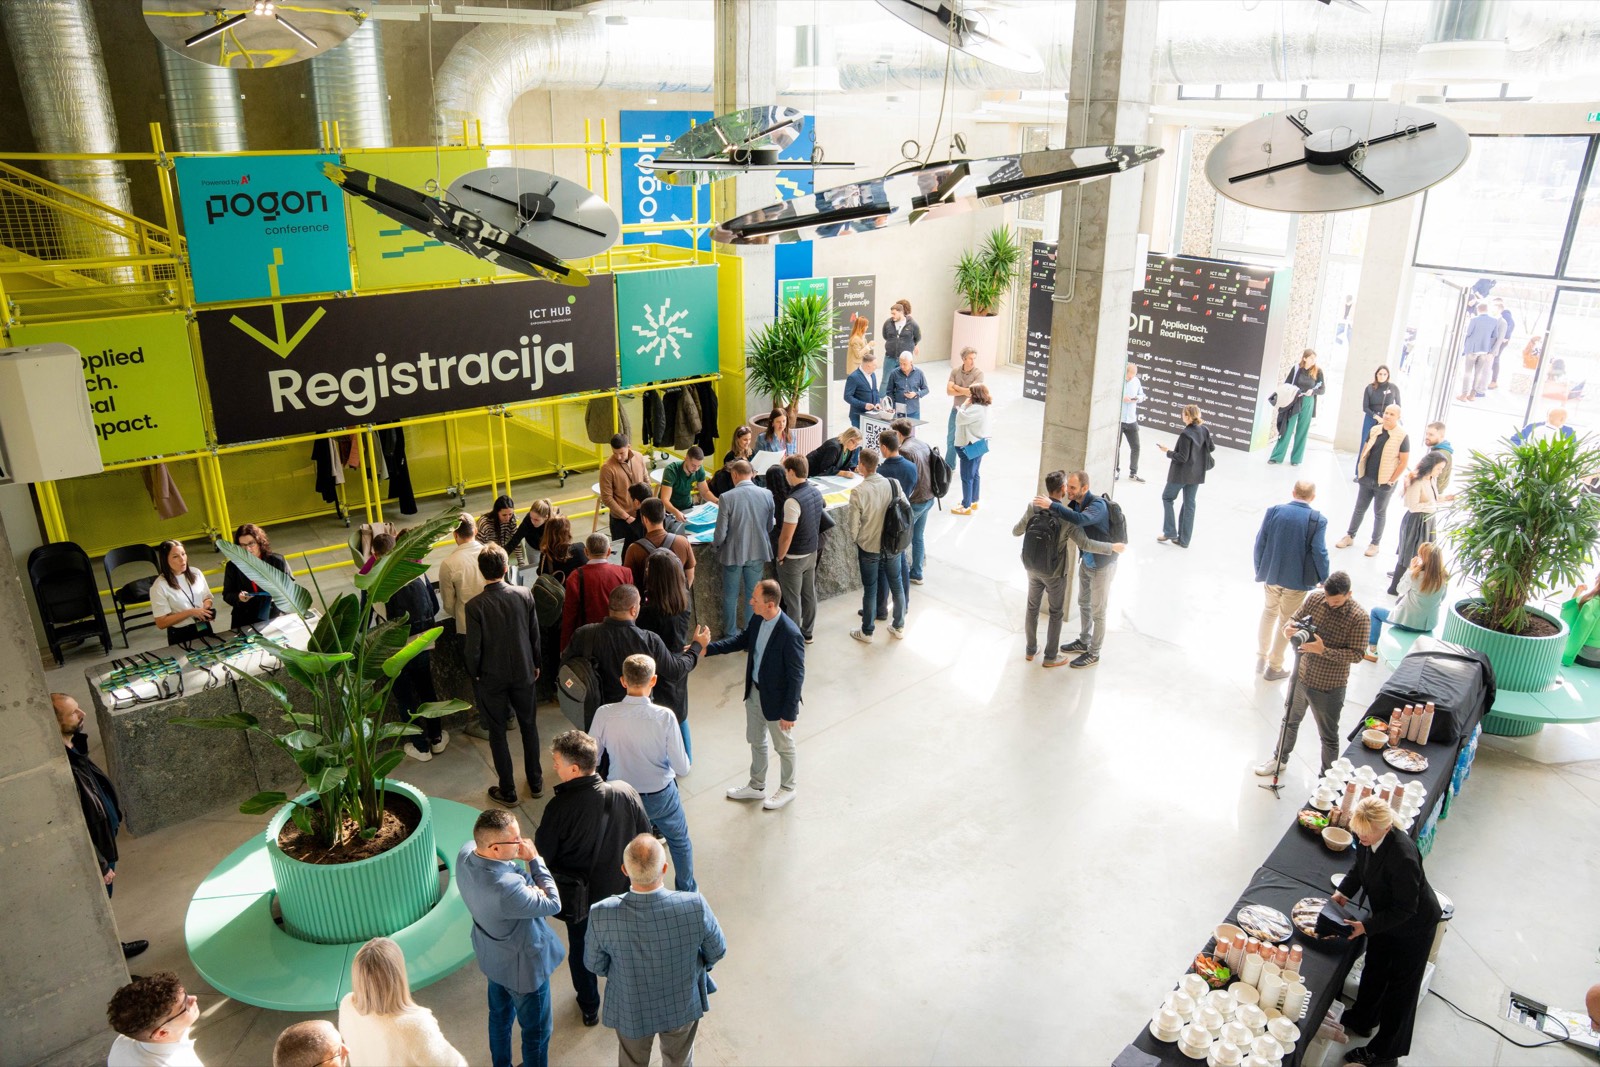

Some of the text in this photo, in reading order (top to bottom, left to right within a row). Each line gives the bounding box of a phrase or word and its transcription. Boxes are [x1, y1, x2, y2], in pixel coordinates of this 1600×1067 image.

[205, 190, 328, 225] pogon
[265, 223, 329, 235] conference
[529, 306, 572, 319] ICT HUB
[1160, 319, 1190, 330] Applied
[1190, 321, 1208, 334] tech.
[1128, 337, 1151, 348] rence
[1160, 329, 1205, 344] Real impact.
[81, 346, 144, 374] plied
[268, 333, 575, 417] Registracija
[94, 414, 158, 440] pact.
